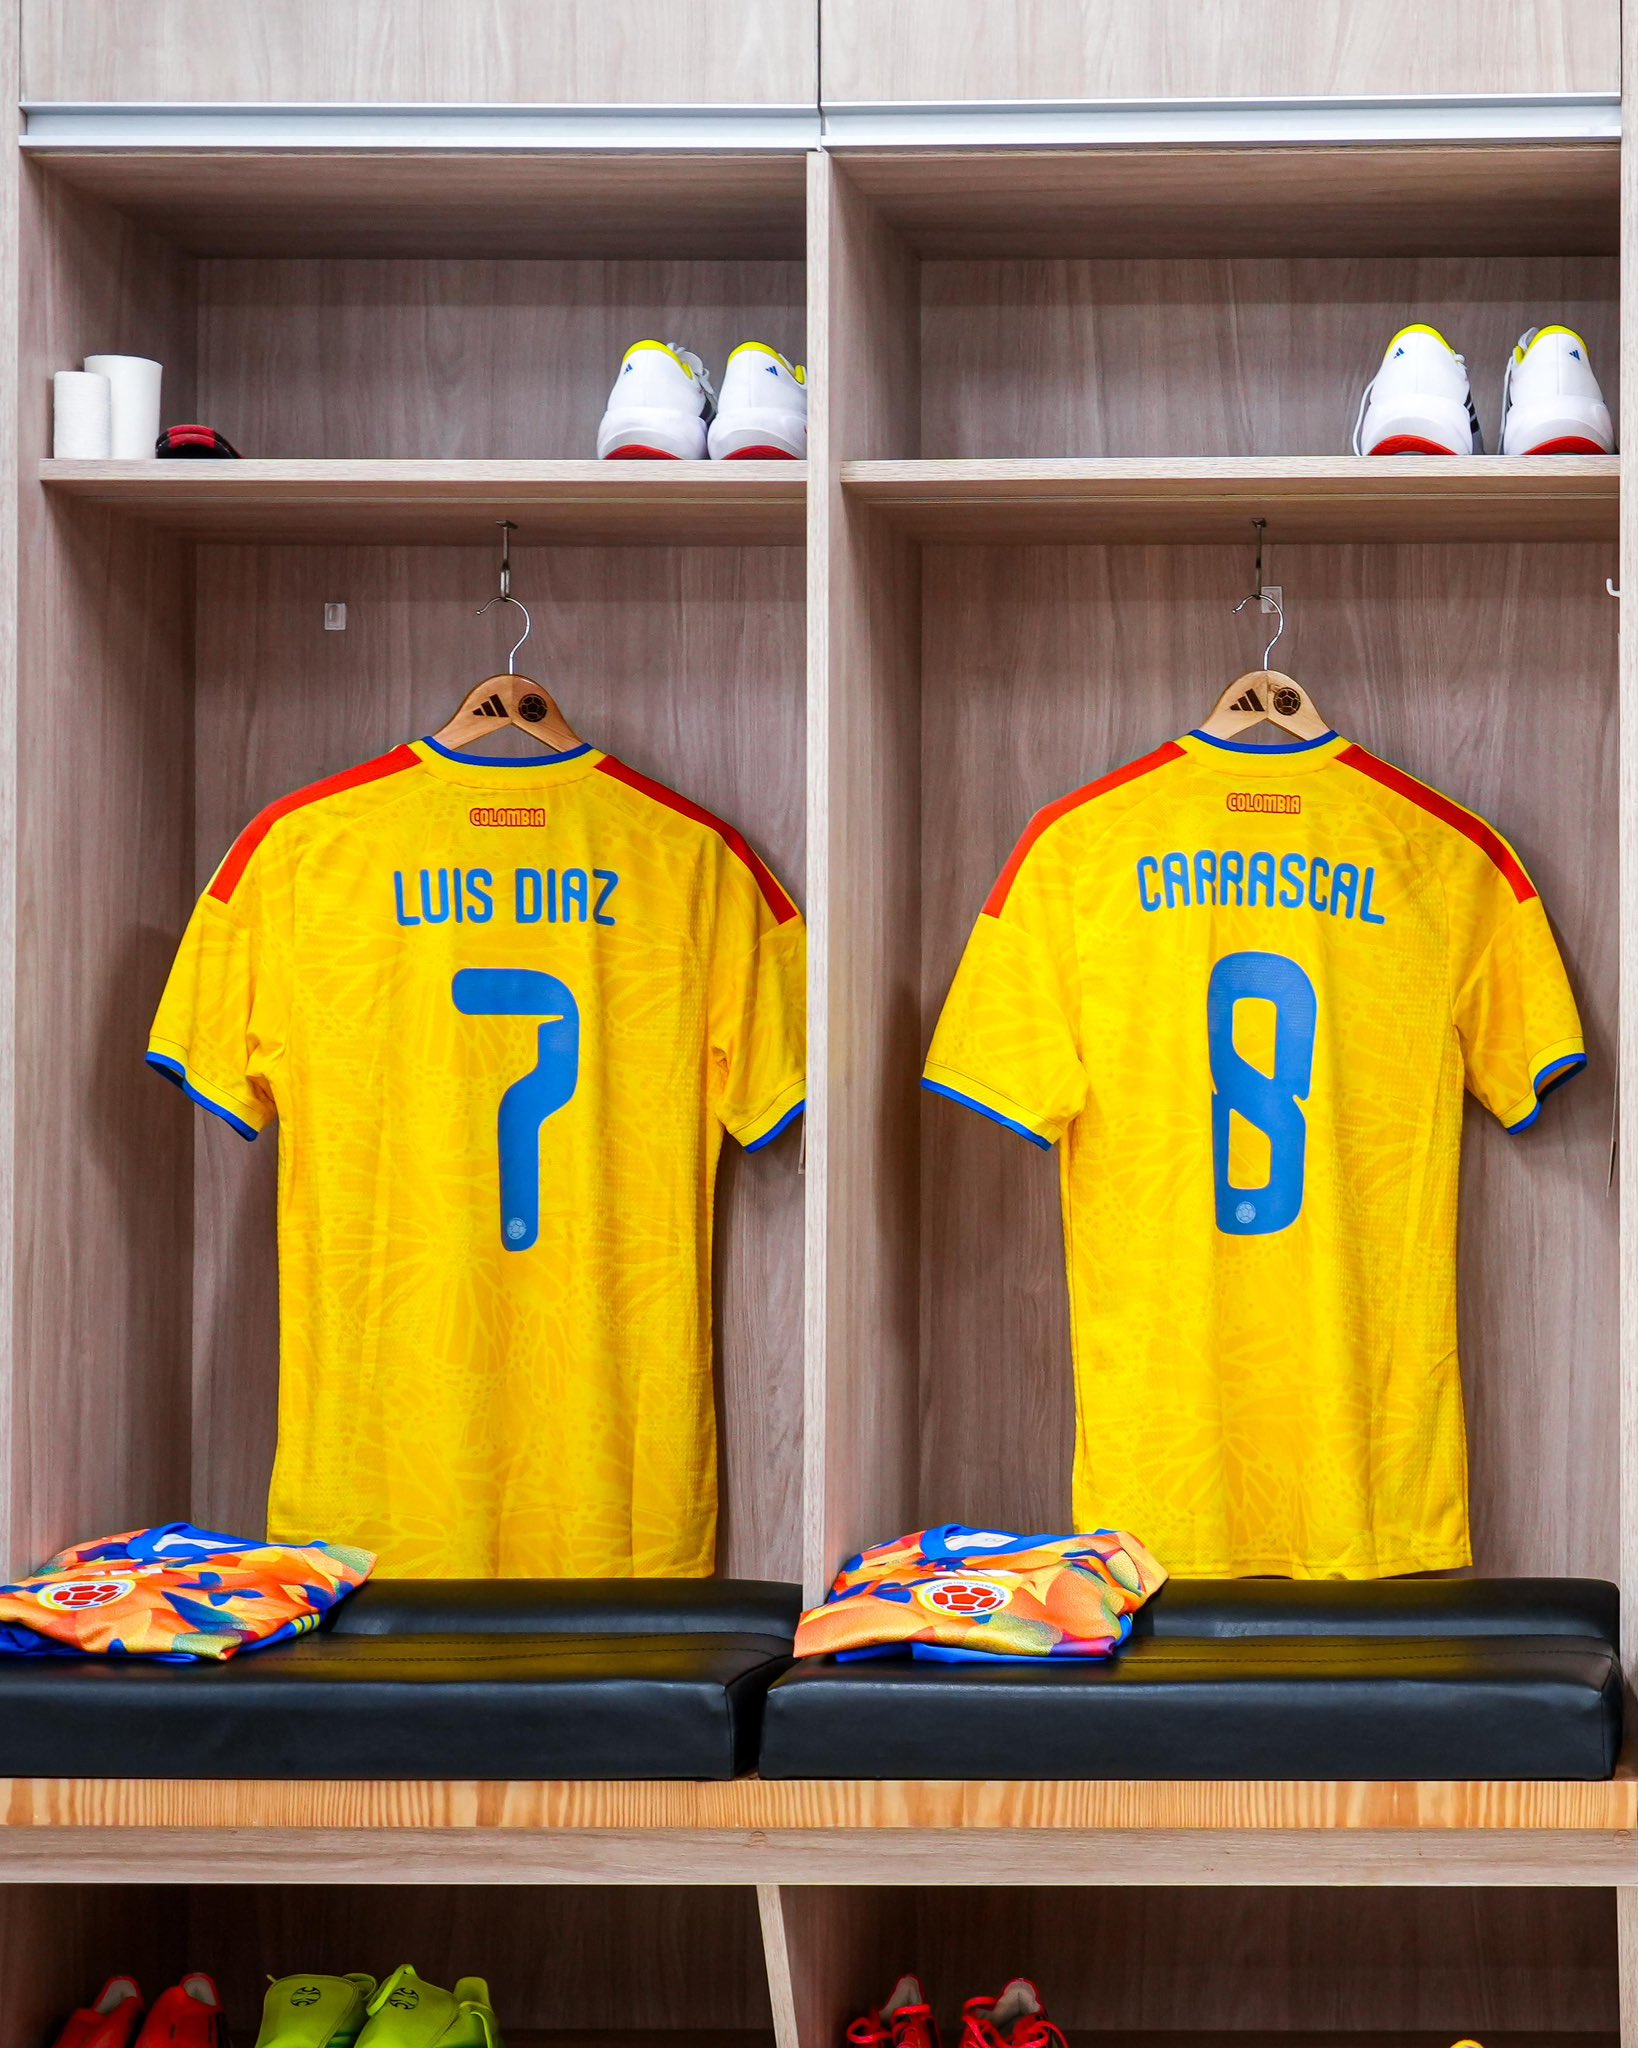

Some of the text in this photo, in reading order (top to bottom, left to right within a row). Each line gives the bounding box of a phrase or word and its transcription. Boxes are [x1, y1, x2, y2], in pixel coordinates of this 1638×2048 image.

[469, 807, 546, 828] COLOMBIA
[1226, 792, 1301, 815] COLOMBIA
[394, 867, 619, 926] LUIS DIAZ
[1136, 850, 1386, 925] CARRASCAL
[452, 968, 580, 1252] 7
[1207, 951, 1318, 1236] 8
